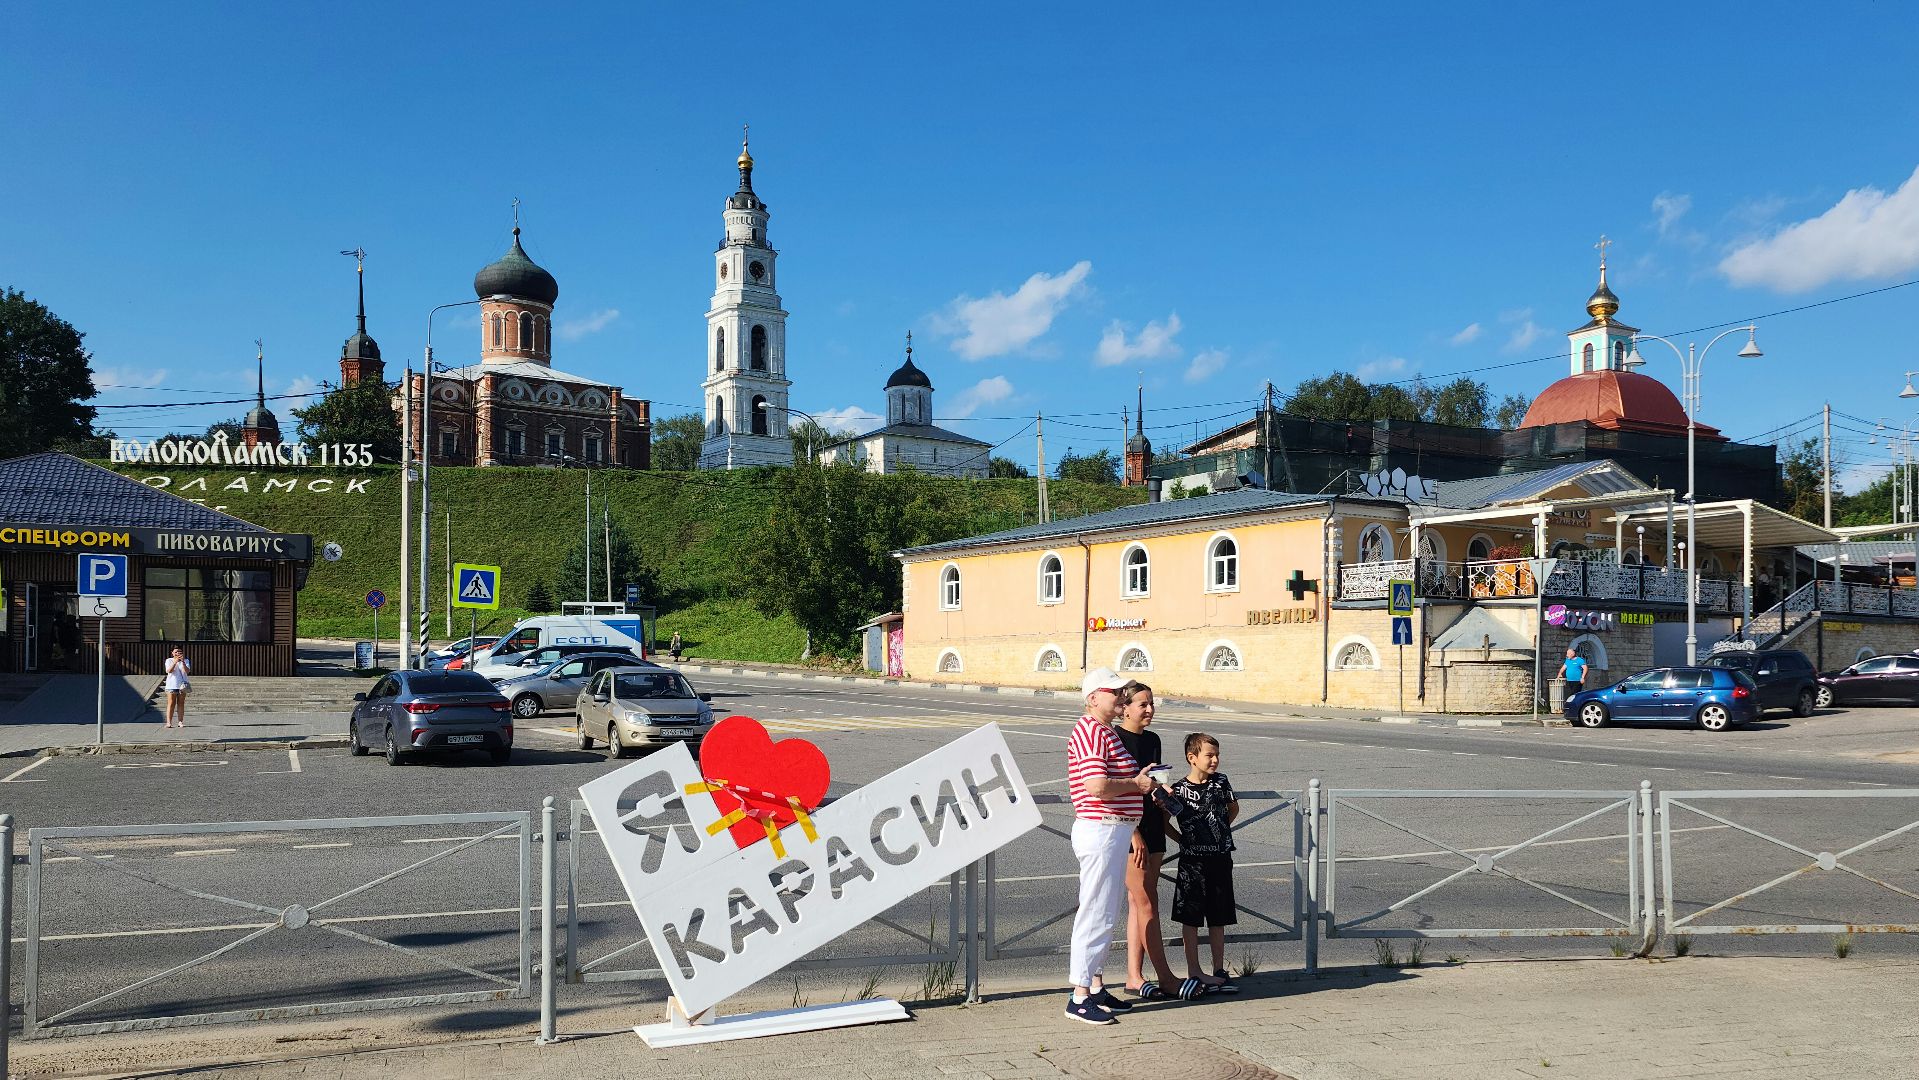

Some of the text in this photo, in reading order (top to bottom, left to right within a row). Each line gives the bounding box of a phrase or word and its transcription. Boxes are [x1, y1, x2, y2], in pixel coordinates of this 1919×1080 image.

[318, 442, 374, 467] 1135
[138, 475, 372, 494] ОЛАМСК
[0, 527, 131, 548] СПЕЦФОРМ
[157, 532, 285, 553] ПИВОВАРИУС
[89, 558, 116, 591] P
[1106, 617, 1144, 629] Маркет
[1247, 608, 1316, 625] ЮВЕЛИР
[1565, 610, 1616, 631] OZON
[1620, 612, 1655, 625] ЮВЕЛИР
[616, 770, 702, 874] Я
[662, 753, 1022, 980] КАРАСИН
